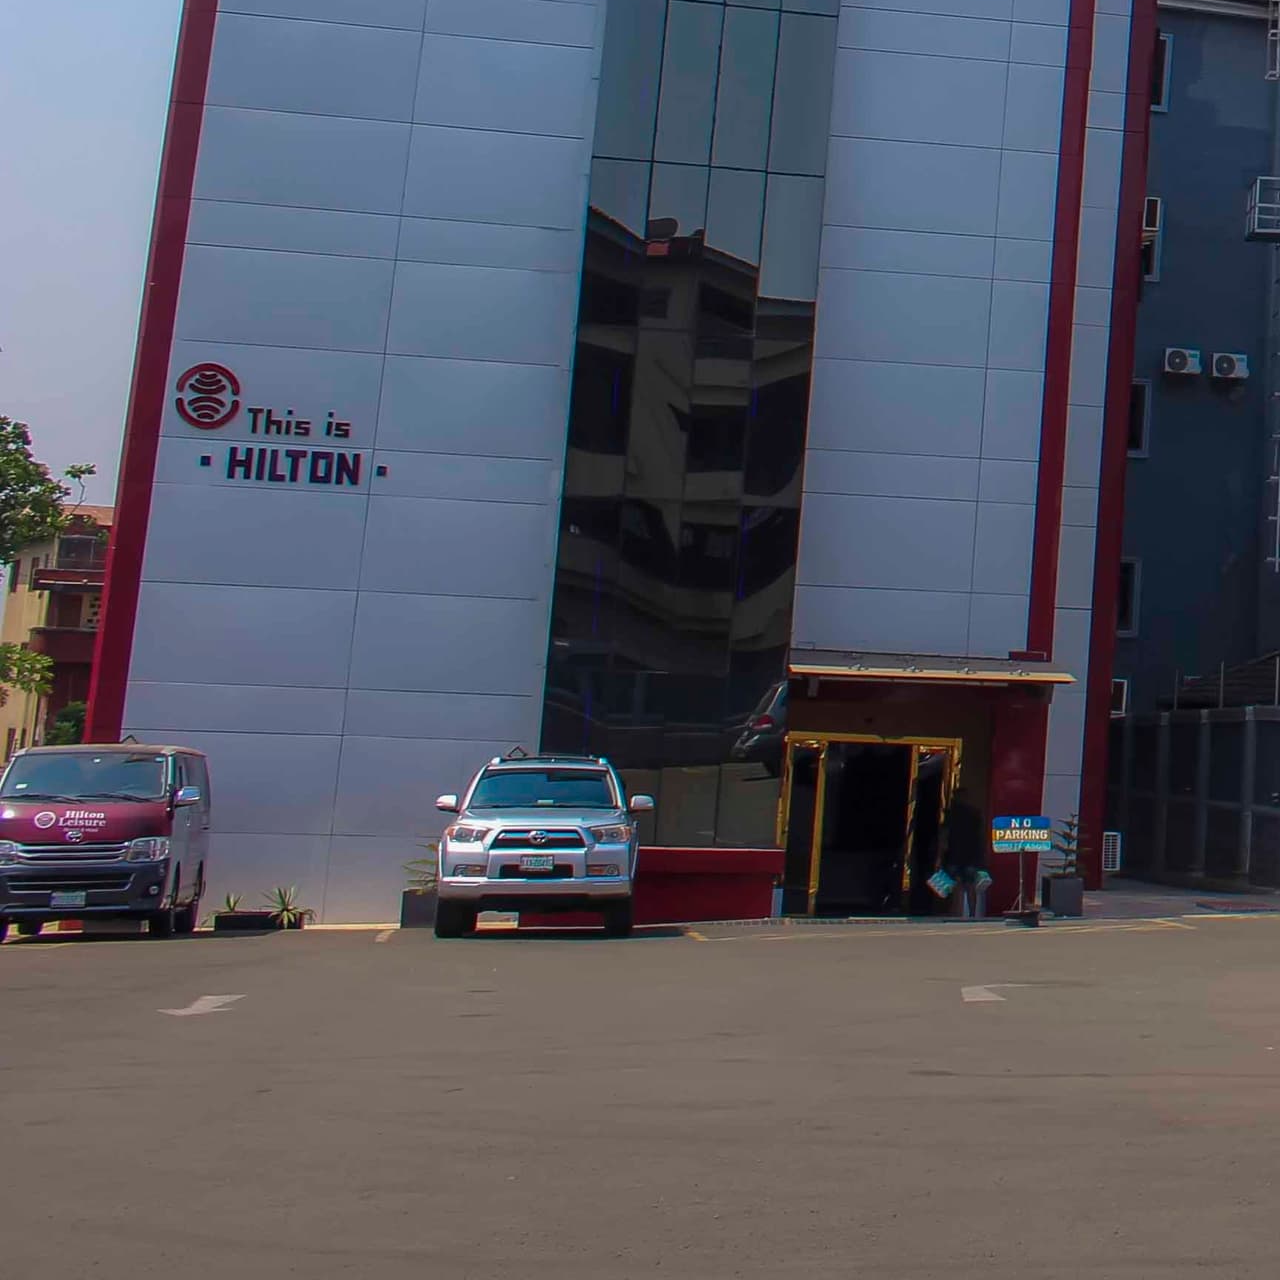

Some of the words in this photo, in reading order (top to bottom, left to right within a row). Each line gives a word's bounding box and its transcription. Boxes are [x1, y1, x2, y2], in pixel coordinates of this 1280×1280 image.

[247, 407, 311, 437] This
[325, 411, 351, 439] is
[226, 445, 362, 486] HILTON
[64, 810, 105, 819] Hilton
[57, 816, 106, 827] Leisure
[996, 829, 1048, 841] PARKING
